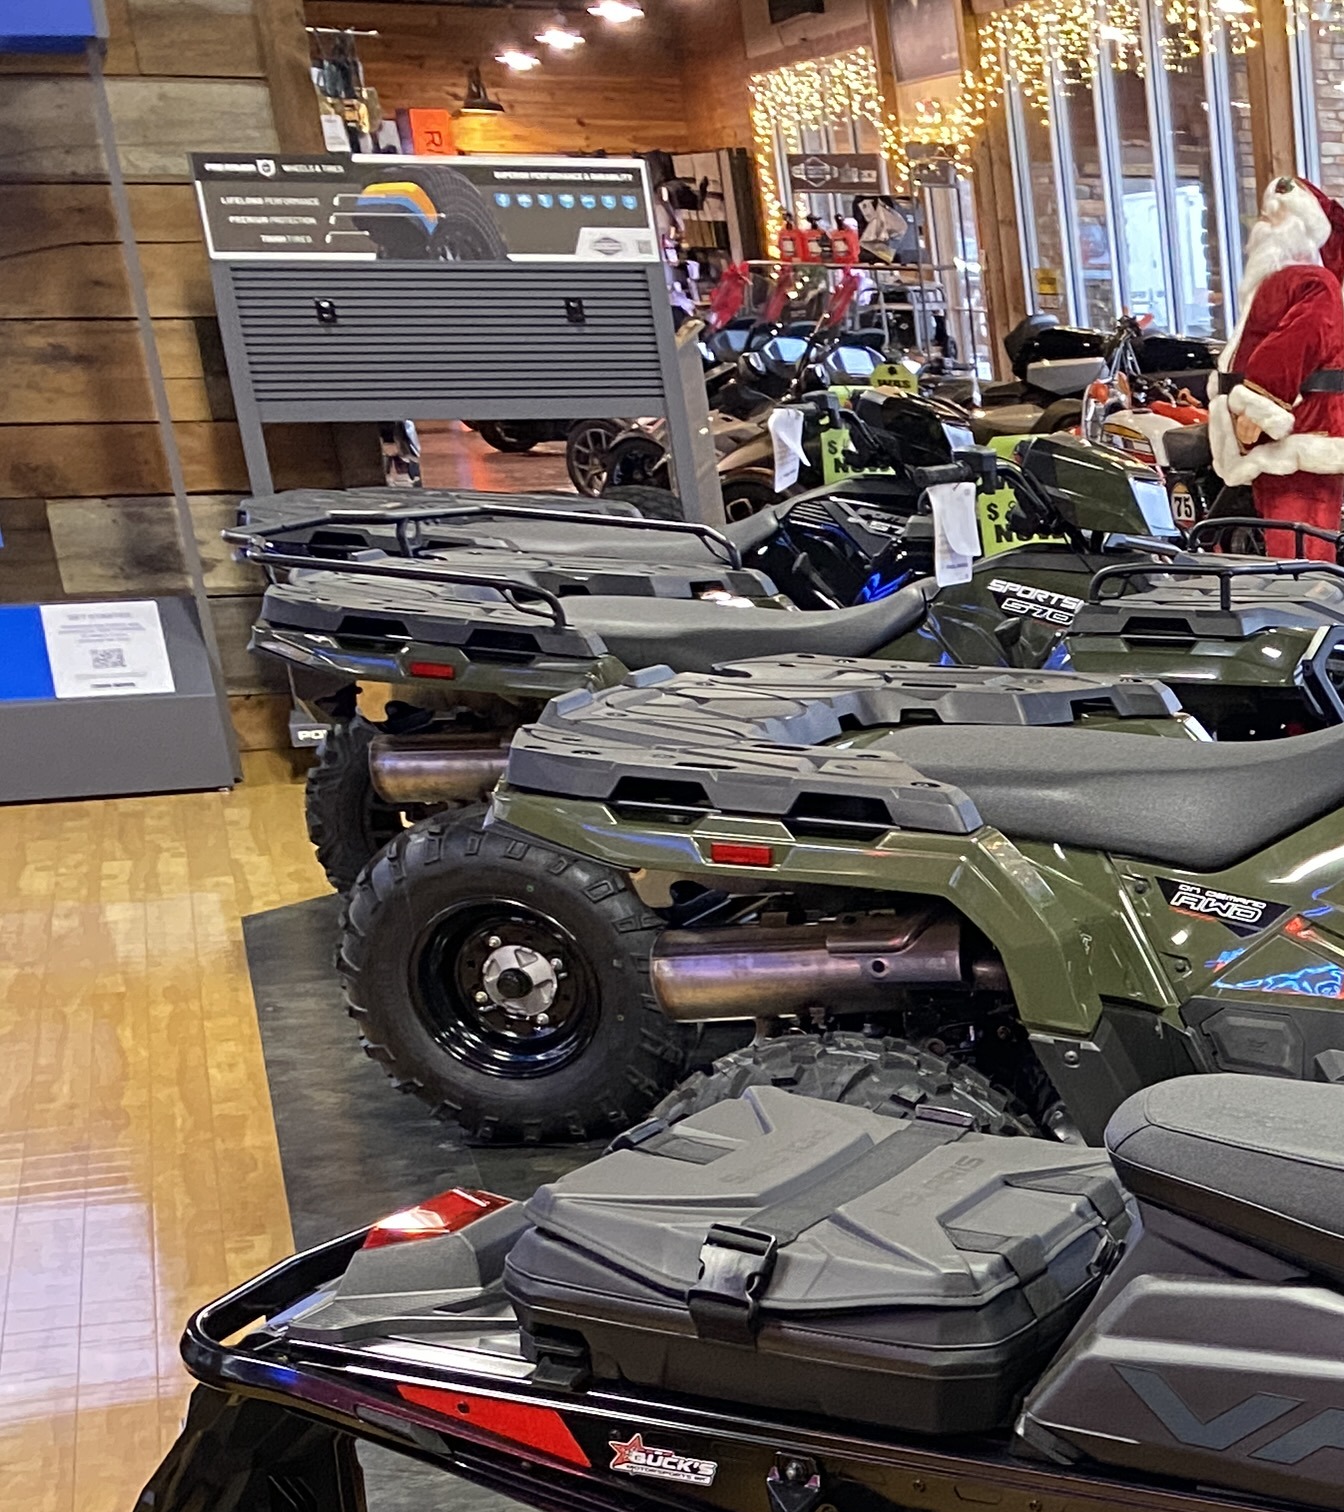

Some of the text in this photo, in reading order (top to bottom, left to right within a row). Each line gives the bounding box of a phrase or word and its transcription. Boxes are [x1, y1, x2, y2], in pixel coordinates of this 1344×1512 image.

[1173, 496, 1193, 518] 75
[987, 578, 1085, 612] SPORTS
[1002, 598, 1075, 626] 570
[1170, 891, 1262, 923] AWD
[627, 1449, 716, 1476] BUCK'S
